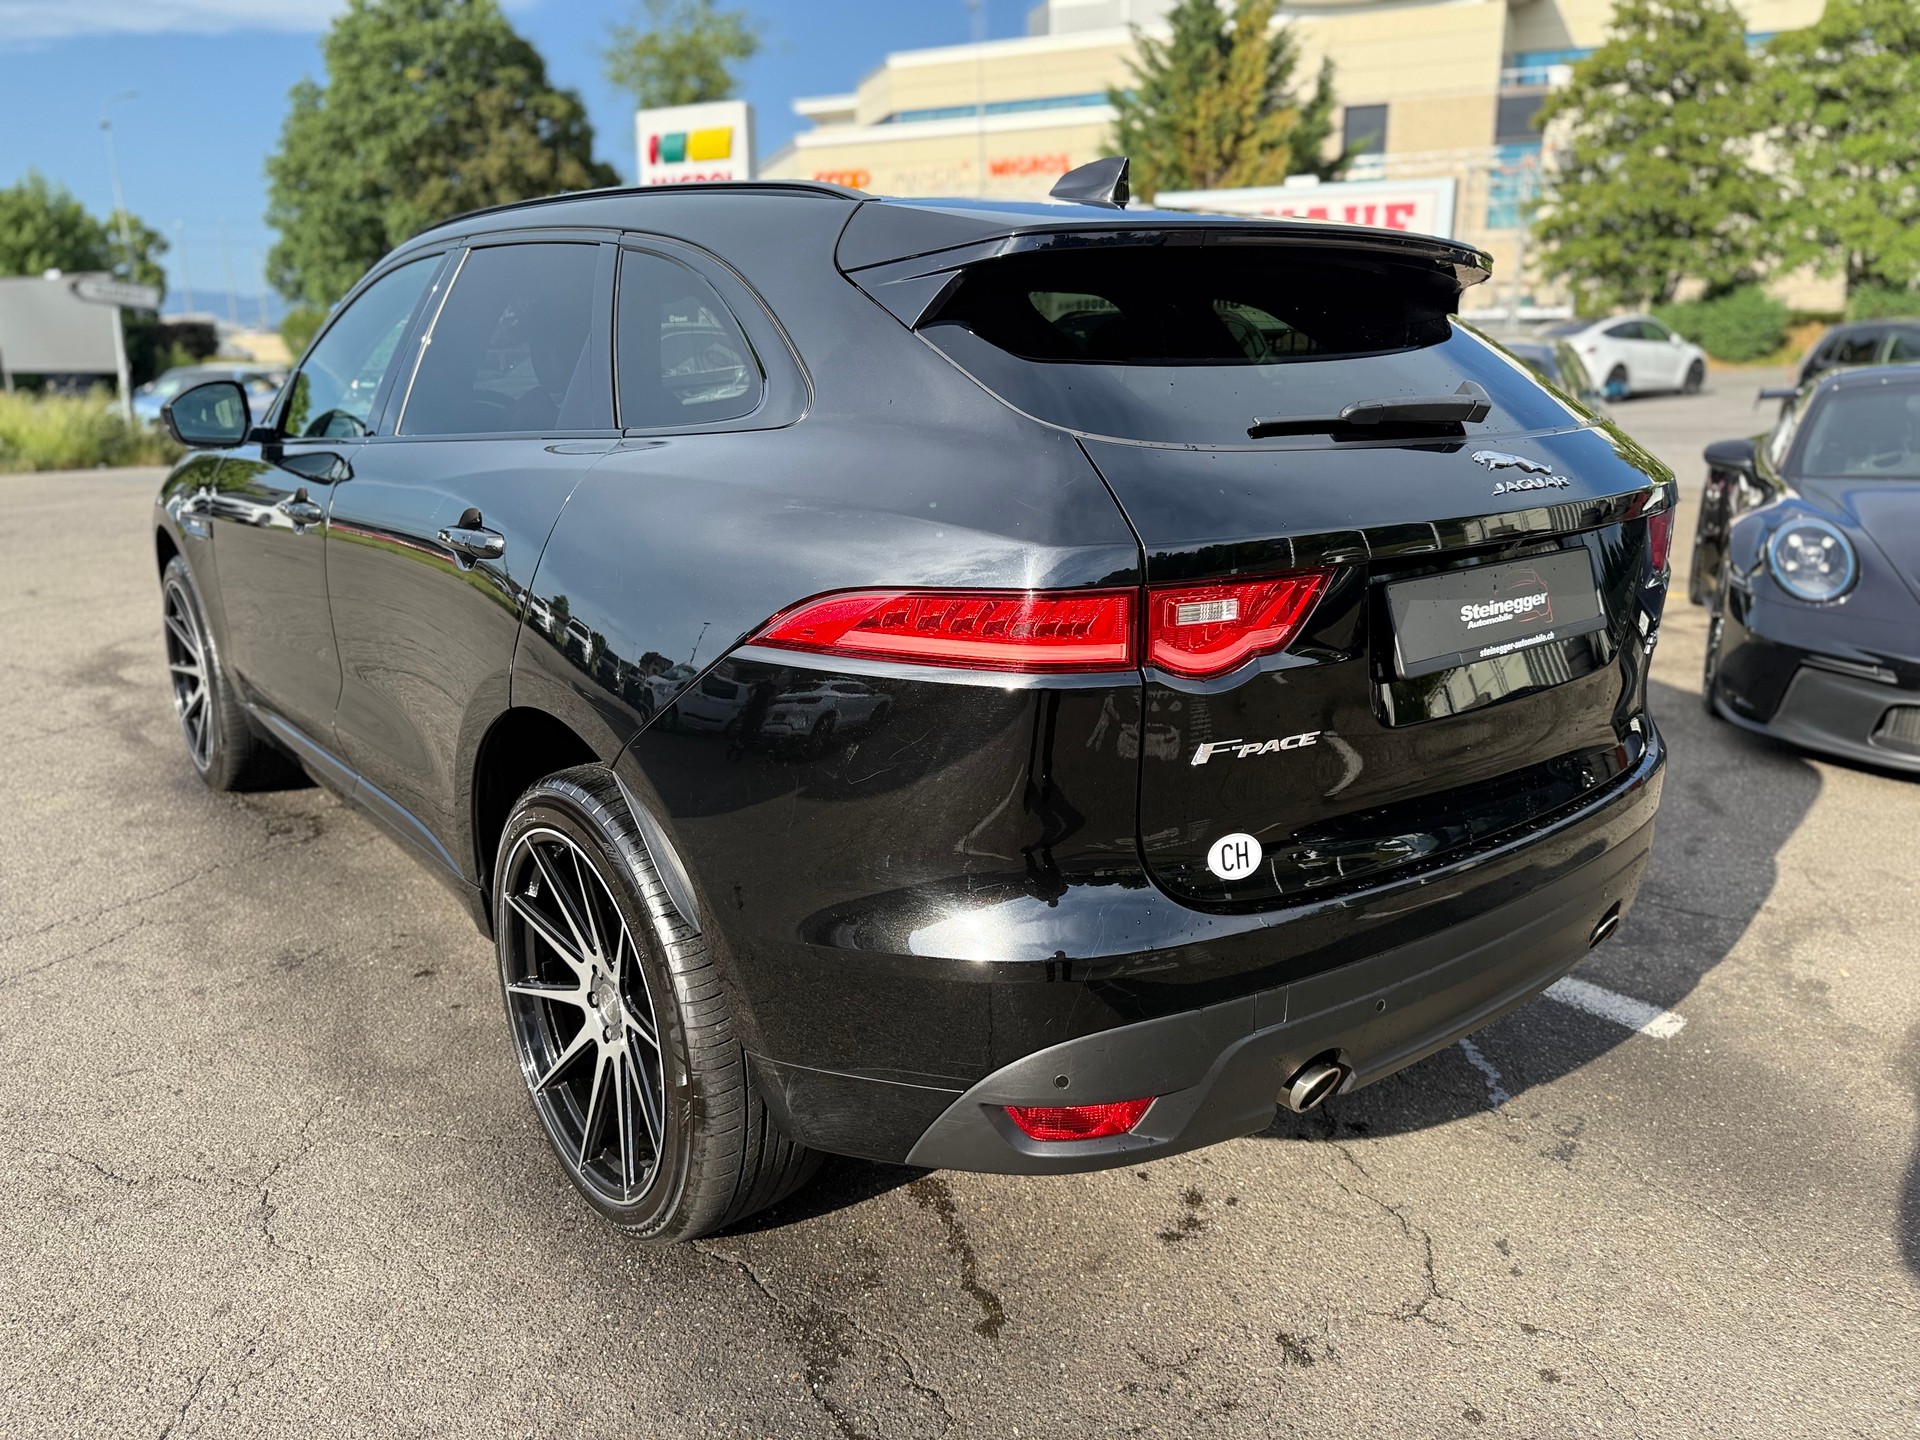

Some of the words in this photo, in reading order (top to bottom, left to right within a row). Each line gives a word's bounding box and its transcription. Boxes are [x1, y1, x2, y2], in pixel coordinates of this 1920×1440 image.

[1491, 475, 1571, 496] JAGUAR
[1460, 592, 1548, 622] Steinegger
[1467, 613, 1514, 630] Automobile
[1480, 631, 1555, 658] steinegger-automobile.ch
[1190, 730, 1321, 767] F-PACE
[1221, 841, 1250, 872] CH
